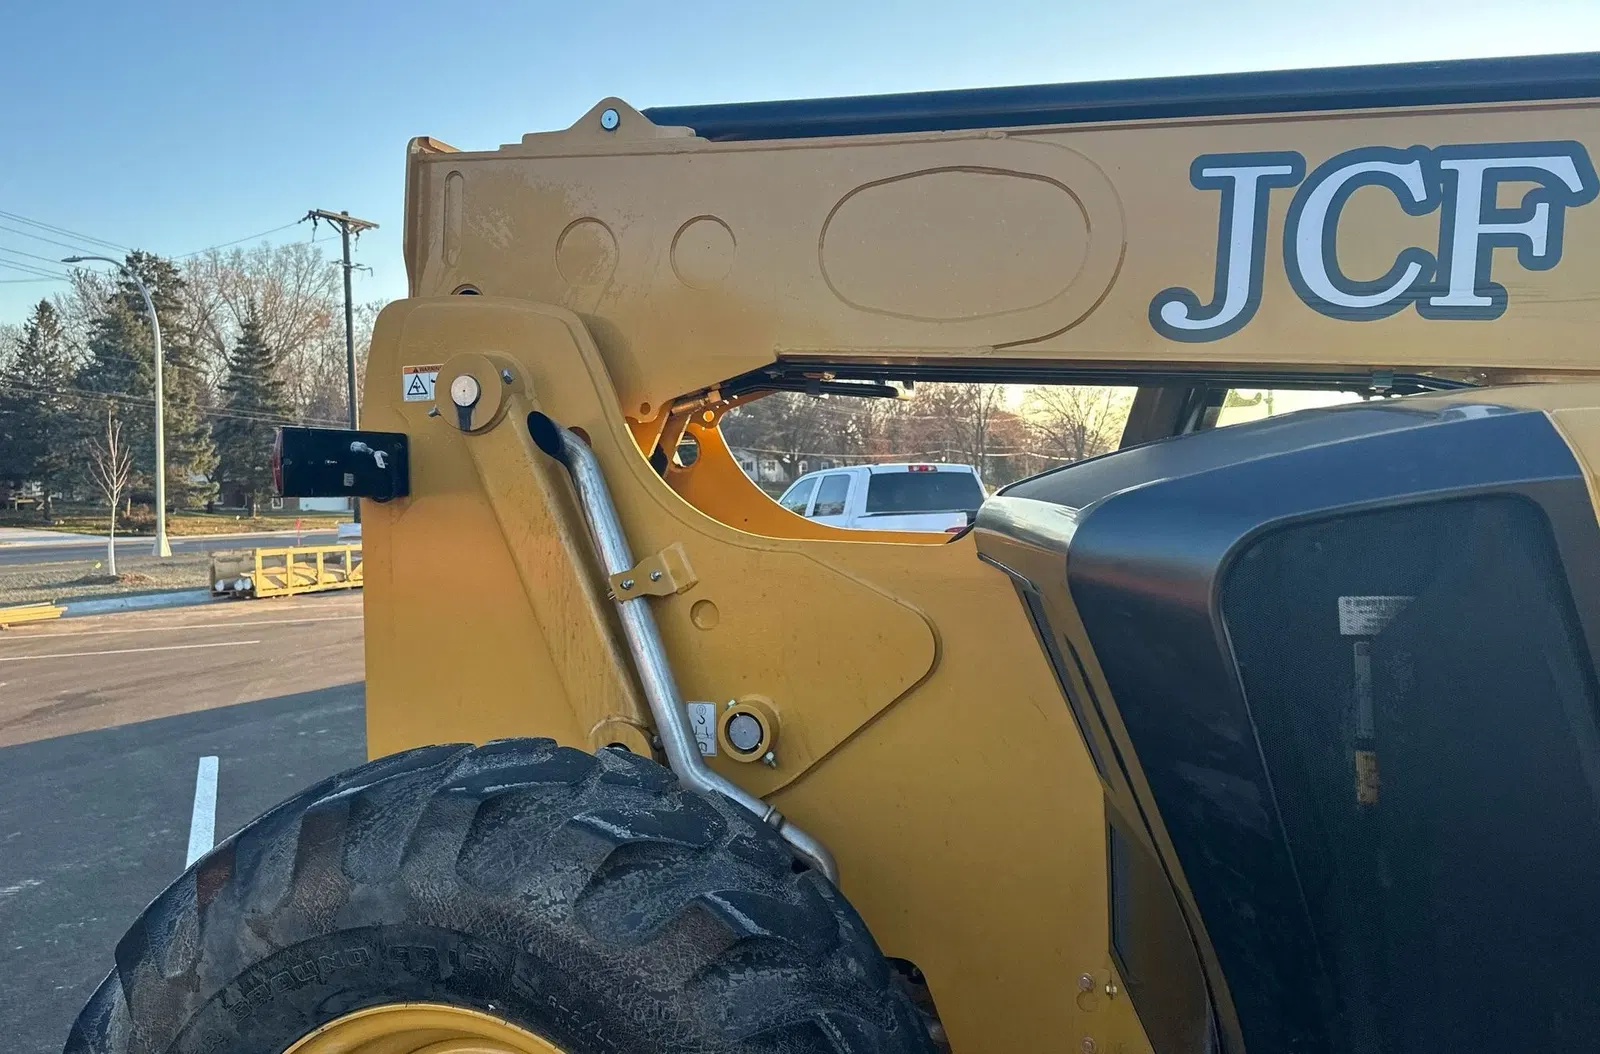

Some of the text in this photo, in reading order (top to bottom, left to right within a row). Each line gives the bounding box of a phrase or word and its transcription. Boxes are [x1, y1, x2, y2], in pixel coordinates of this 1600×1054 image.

[1157, 150, 1588, 334] JCF
[419, 365, 441, 373] WARNIN
[227, 947, 371, 1022] GROUND
